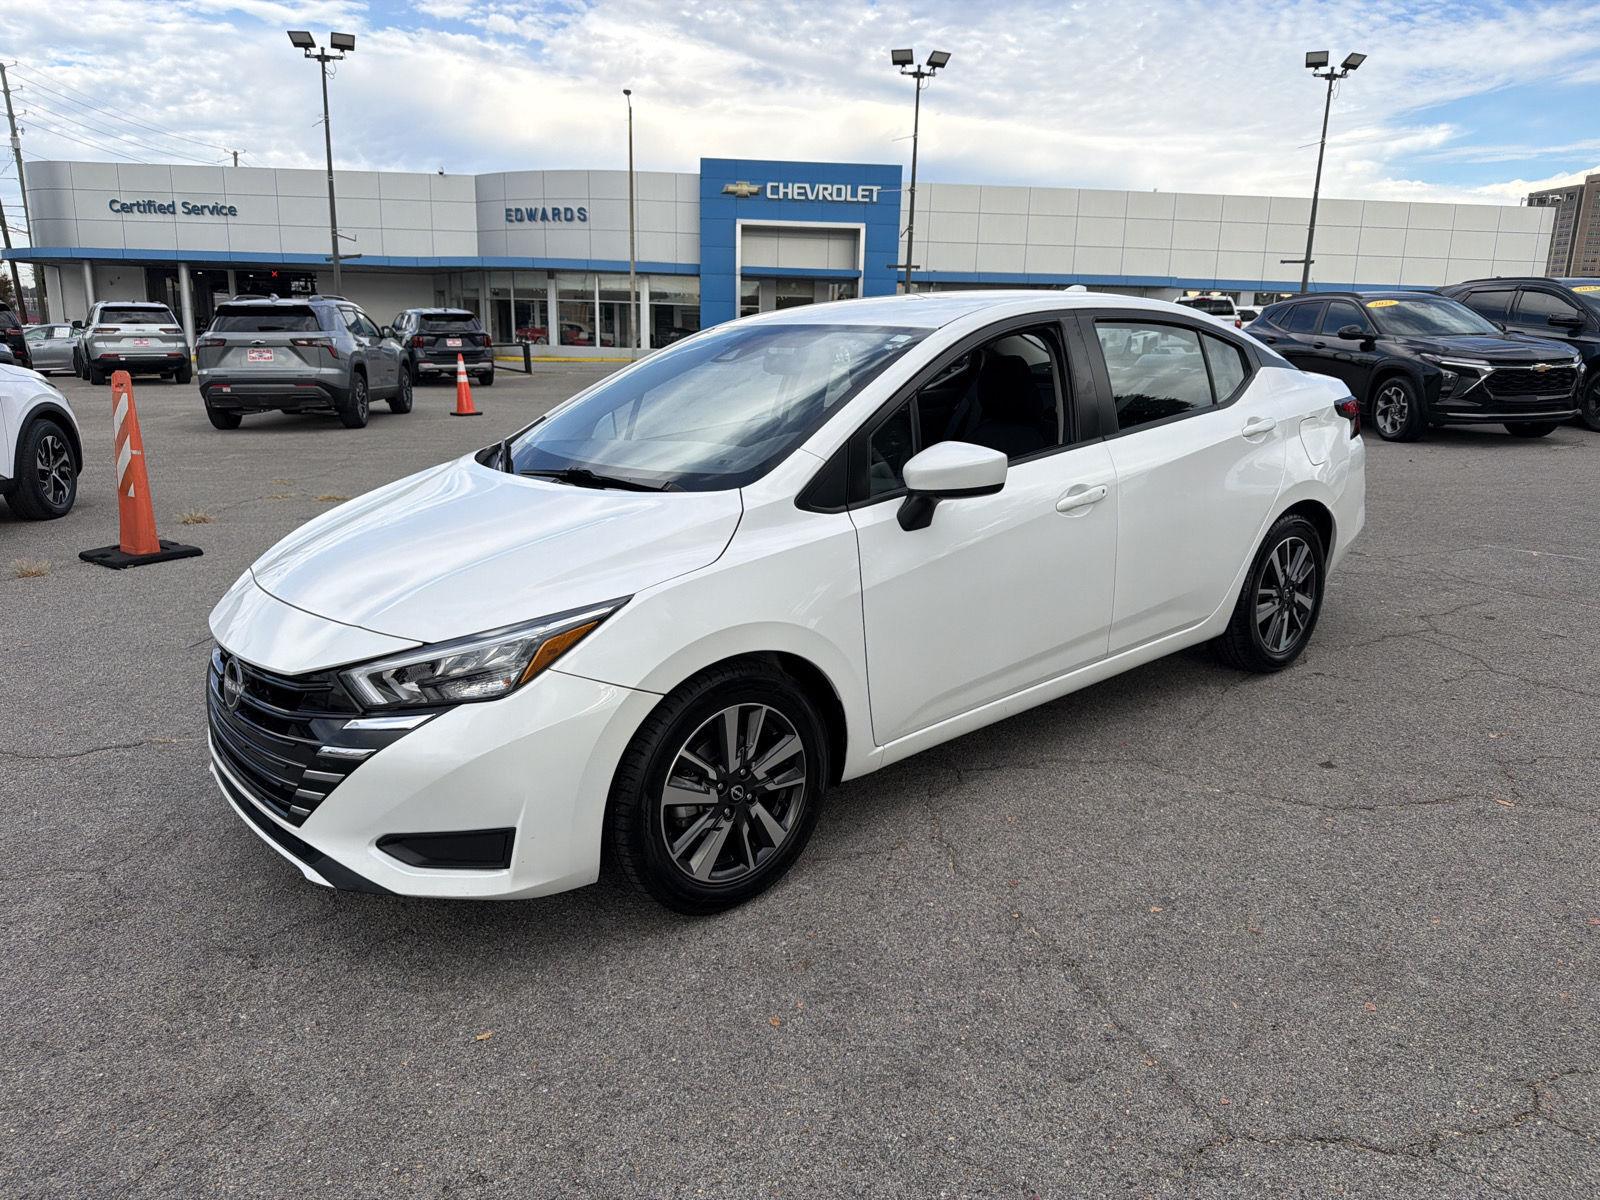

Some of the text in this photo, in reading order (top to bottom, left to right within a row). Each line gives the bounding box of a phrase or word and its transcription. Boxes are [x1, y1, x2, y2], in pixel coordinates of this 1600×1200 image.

[766, 182, 881, 202] CHEVROLET
[109, 199, 237, 216] Certified Service
[505, 206, 588, 222] EDWARDS
